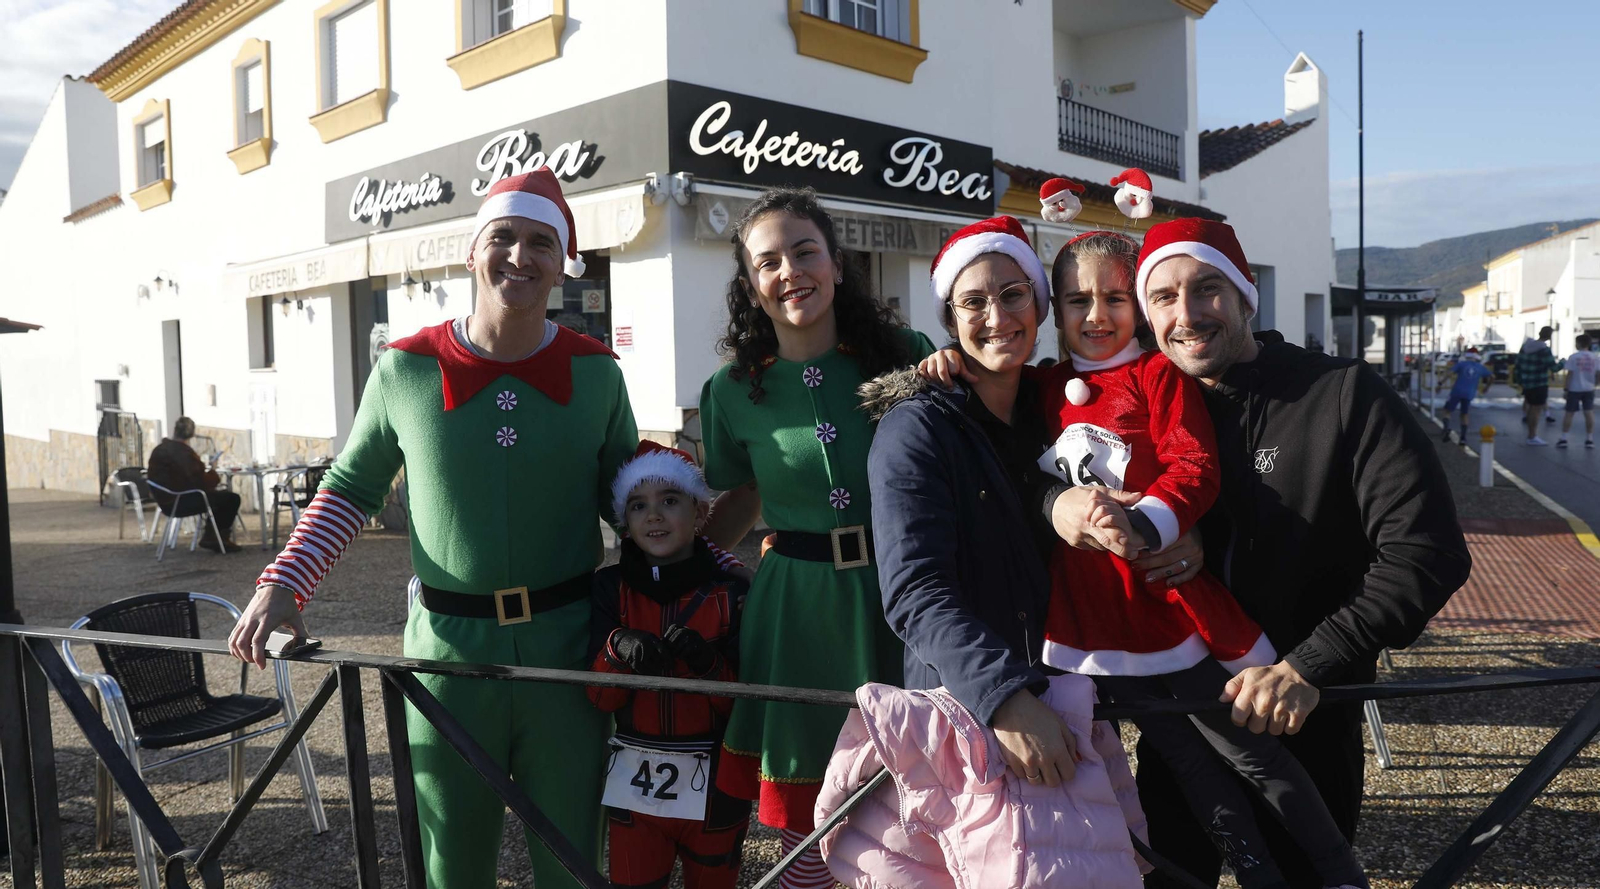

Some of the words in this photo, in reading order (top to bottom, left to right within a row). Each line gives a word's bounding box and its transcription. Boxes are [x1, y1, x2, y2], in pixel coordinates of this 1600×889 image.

[689, 100, 864, 176] Cafetería
[883, 136, 993, 200] Bea
[349, 172, 444, 226] Cafetería
[471, 128, 590, 197] Bea
[832, 217, 918, 250] FETERIA
[249, 267, 299, 292] CAFETERIA
[306, 259, 326, 282] BEA
[630, 759, 679, 800] 42
